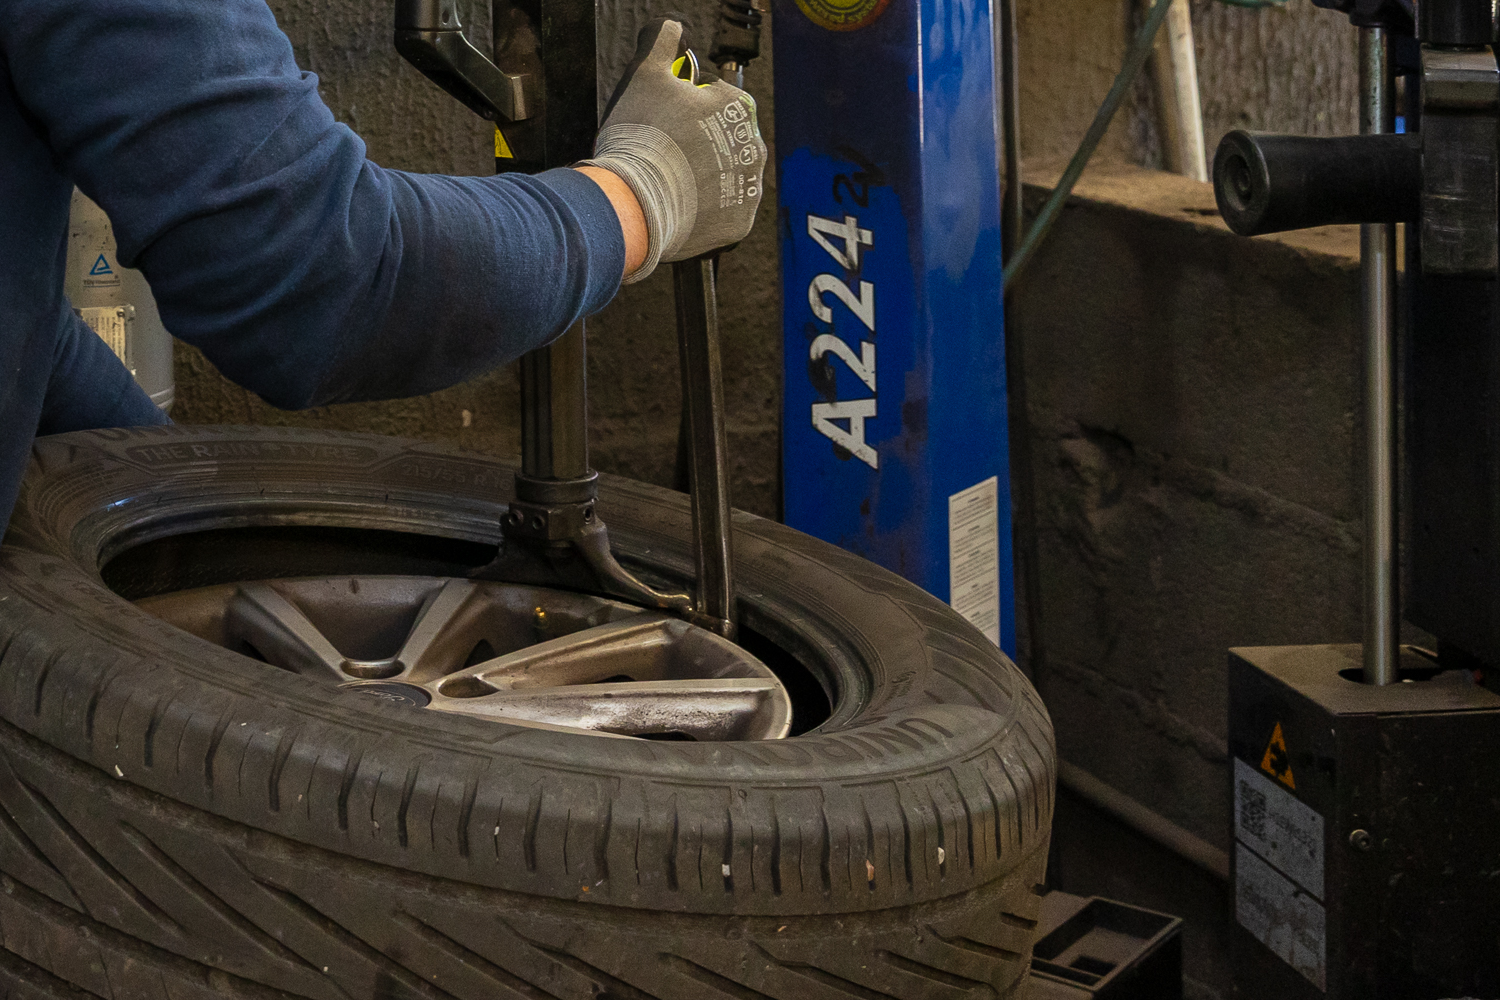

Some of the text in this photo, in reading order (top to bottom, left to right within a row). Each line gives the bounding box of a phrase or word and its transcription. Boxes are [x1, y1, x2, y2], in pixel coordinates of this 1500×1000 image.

[747, 174, 758, 197] 10
[807, 213, 878, 470] A224
[136, 447, 188, 461] THE
